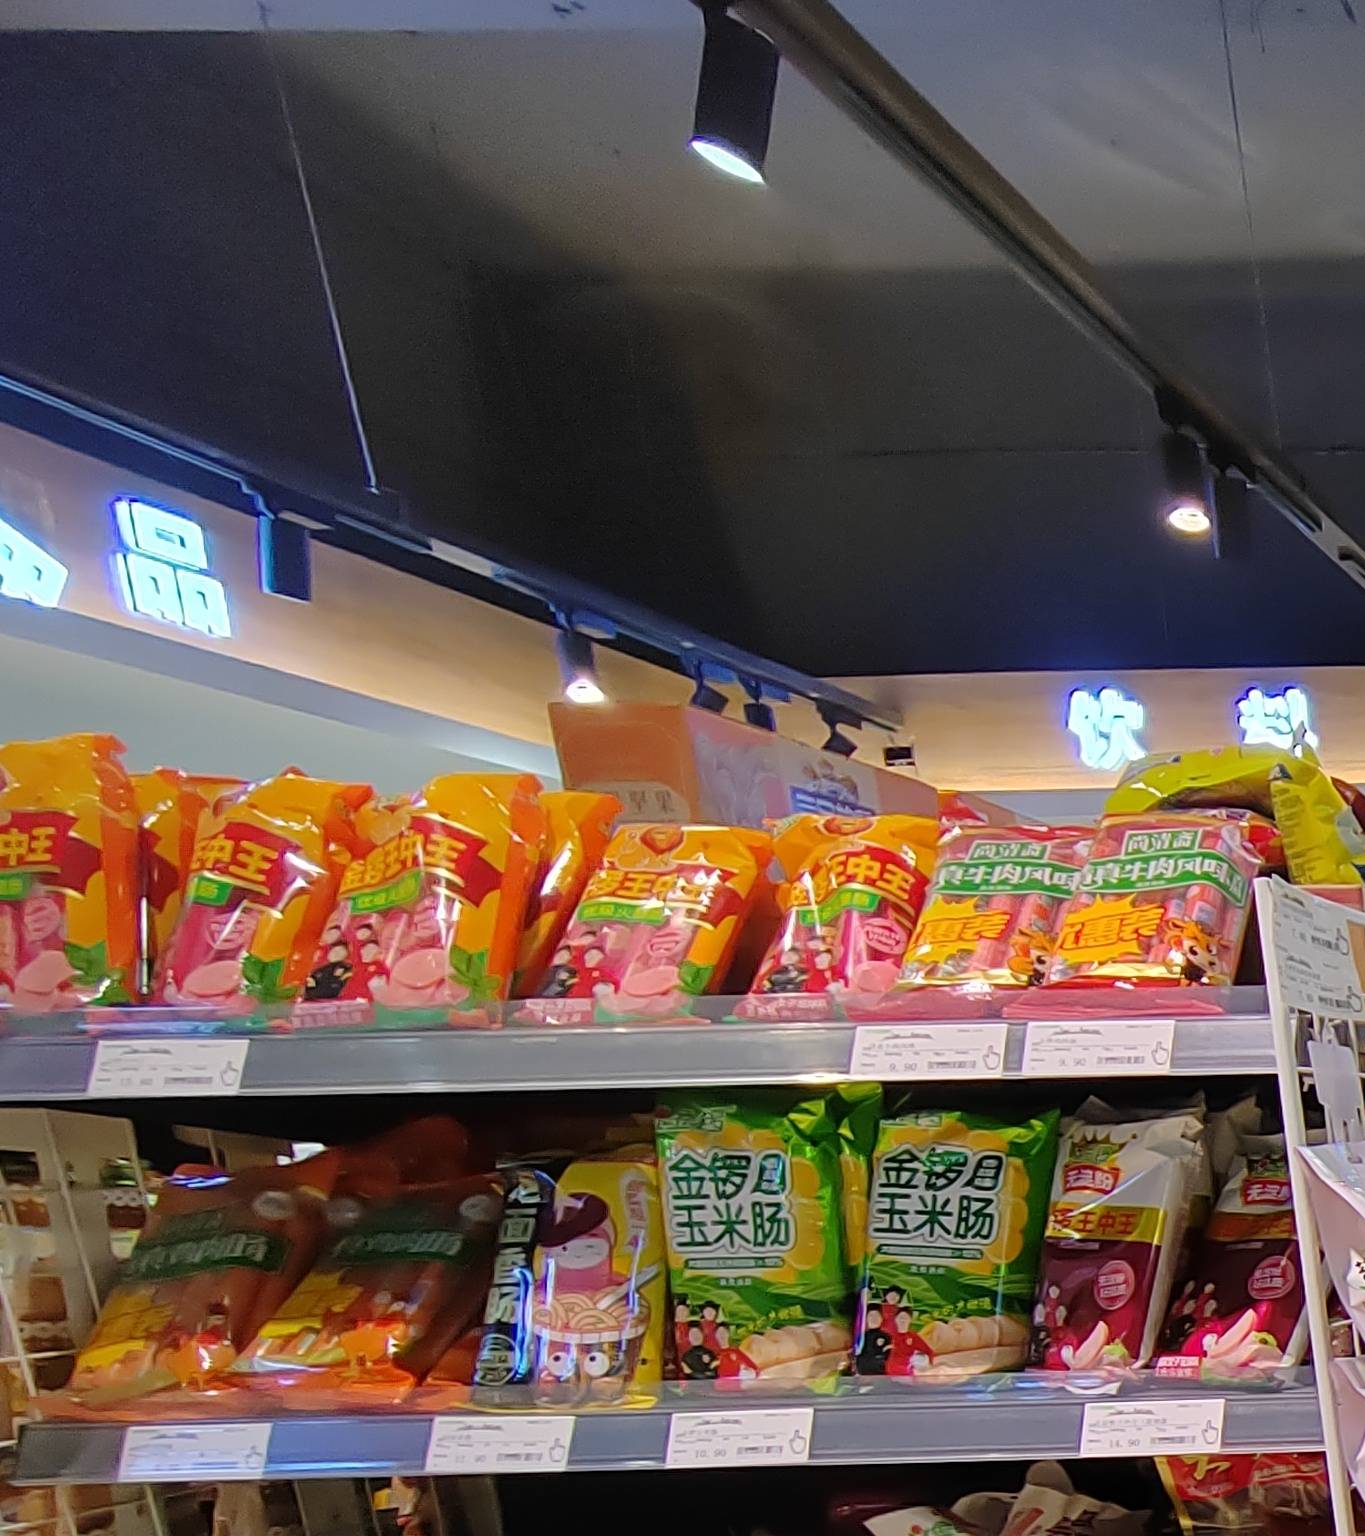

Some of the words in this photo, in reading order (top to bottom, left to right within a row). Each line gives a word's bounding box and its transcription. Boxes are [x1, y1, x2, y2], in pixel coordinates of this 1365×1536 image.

[669, 1151, 751, 1201] 金锣
[877, 1148, 969, 1193] 金锣
[672, 1201, 790, 1249] 玉米肠
[872, 1192, 996, 1240] 玉米肠
[1109, 1437, 1140, 1448] 14.90
